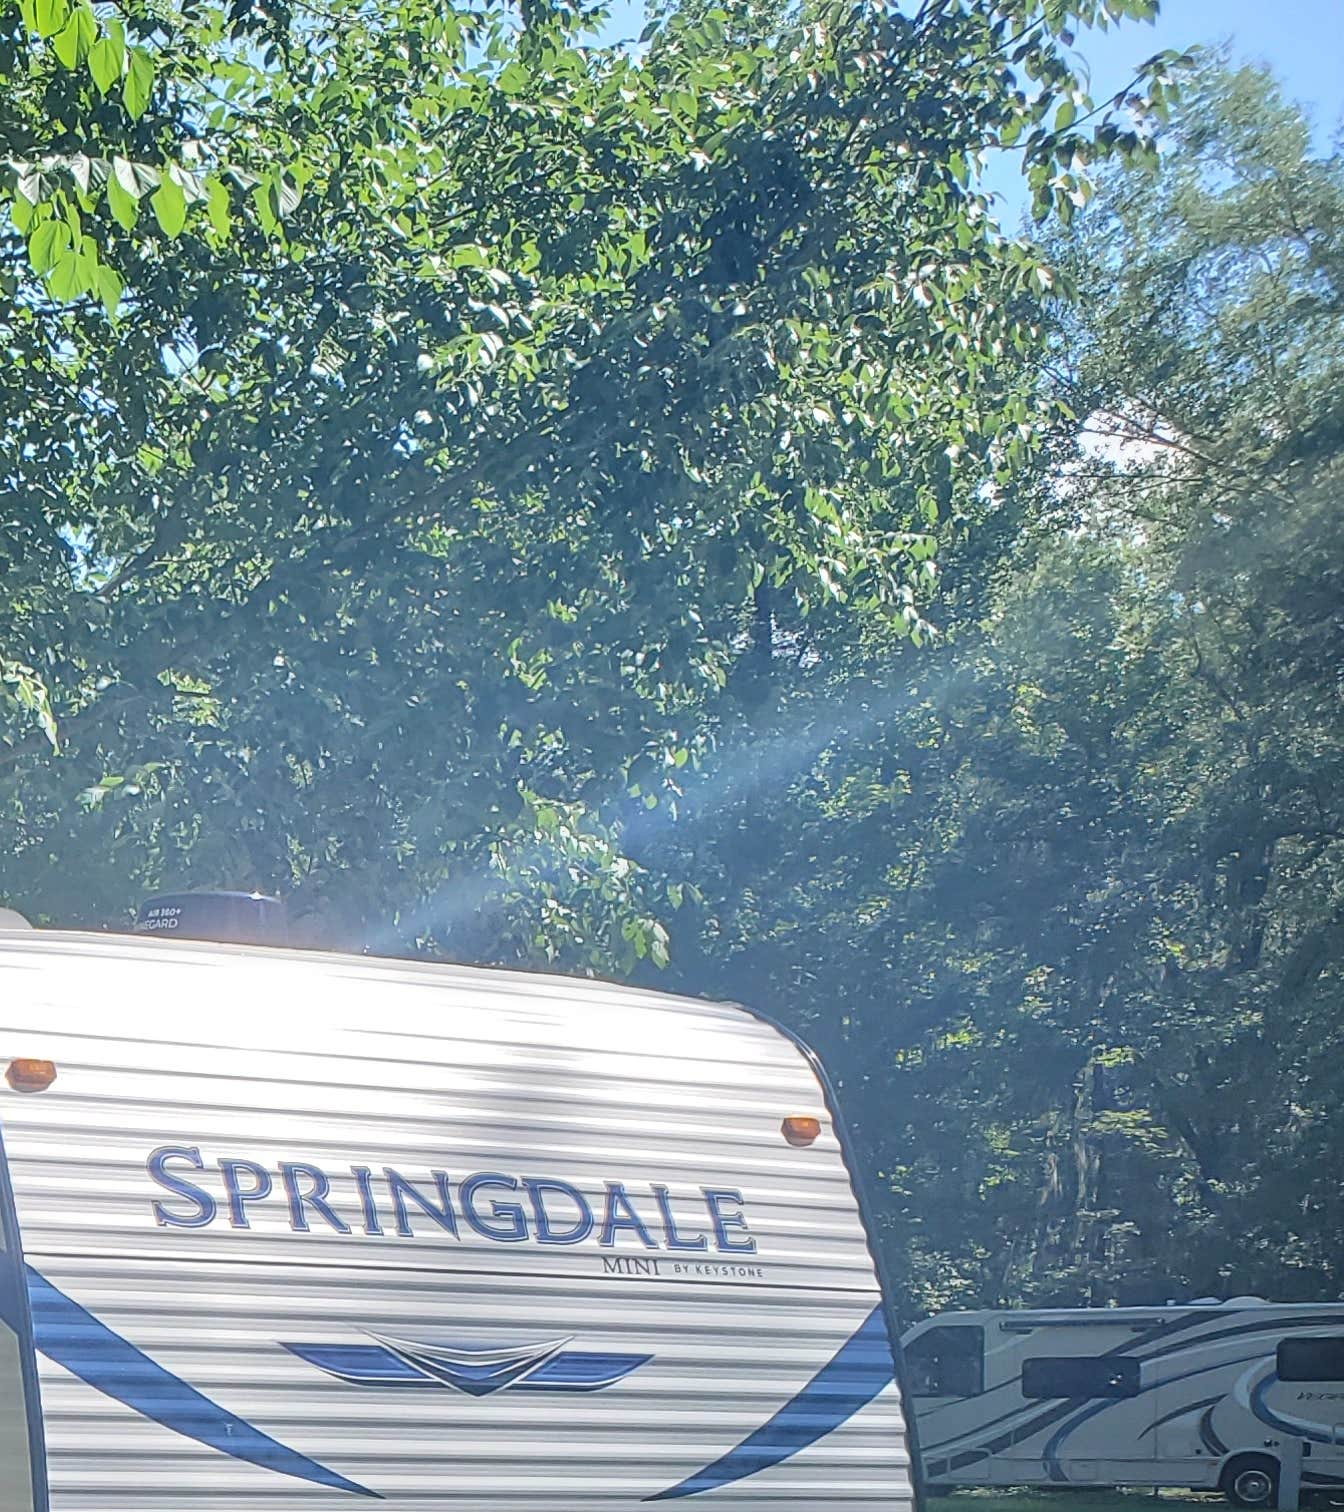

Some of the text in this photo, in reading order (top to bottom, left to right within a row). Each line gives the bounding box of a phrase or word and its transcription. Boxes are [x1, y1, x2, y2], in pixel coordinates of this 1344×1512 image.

[144, 1144, 758, 1255] SPRINGDALE
[601, 1256, 765, 1278] MINI BY KEYSTONE
